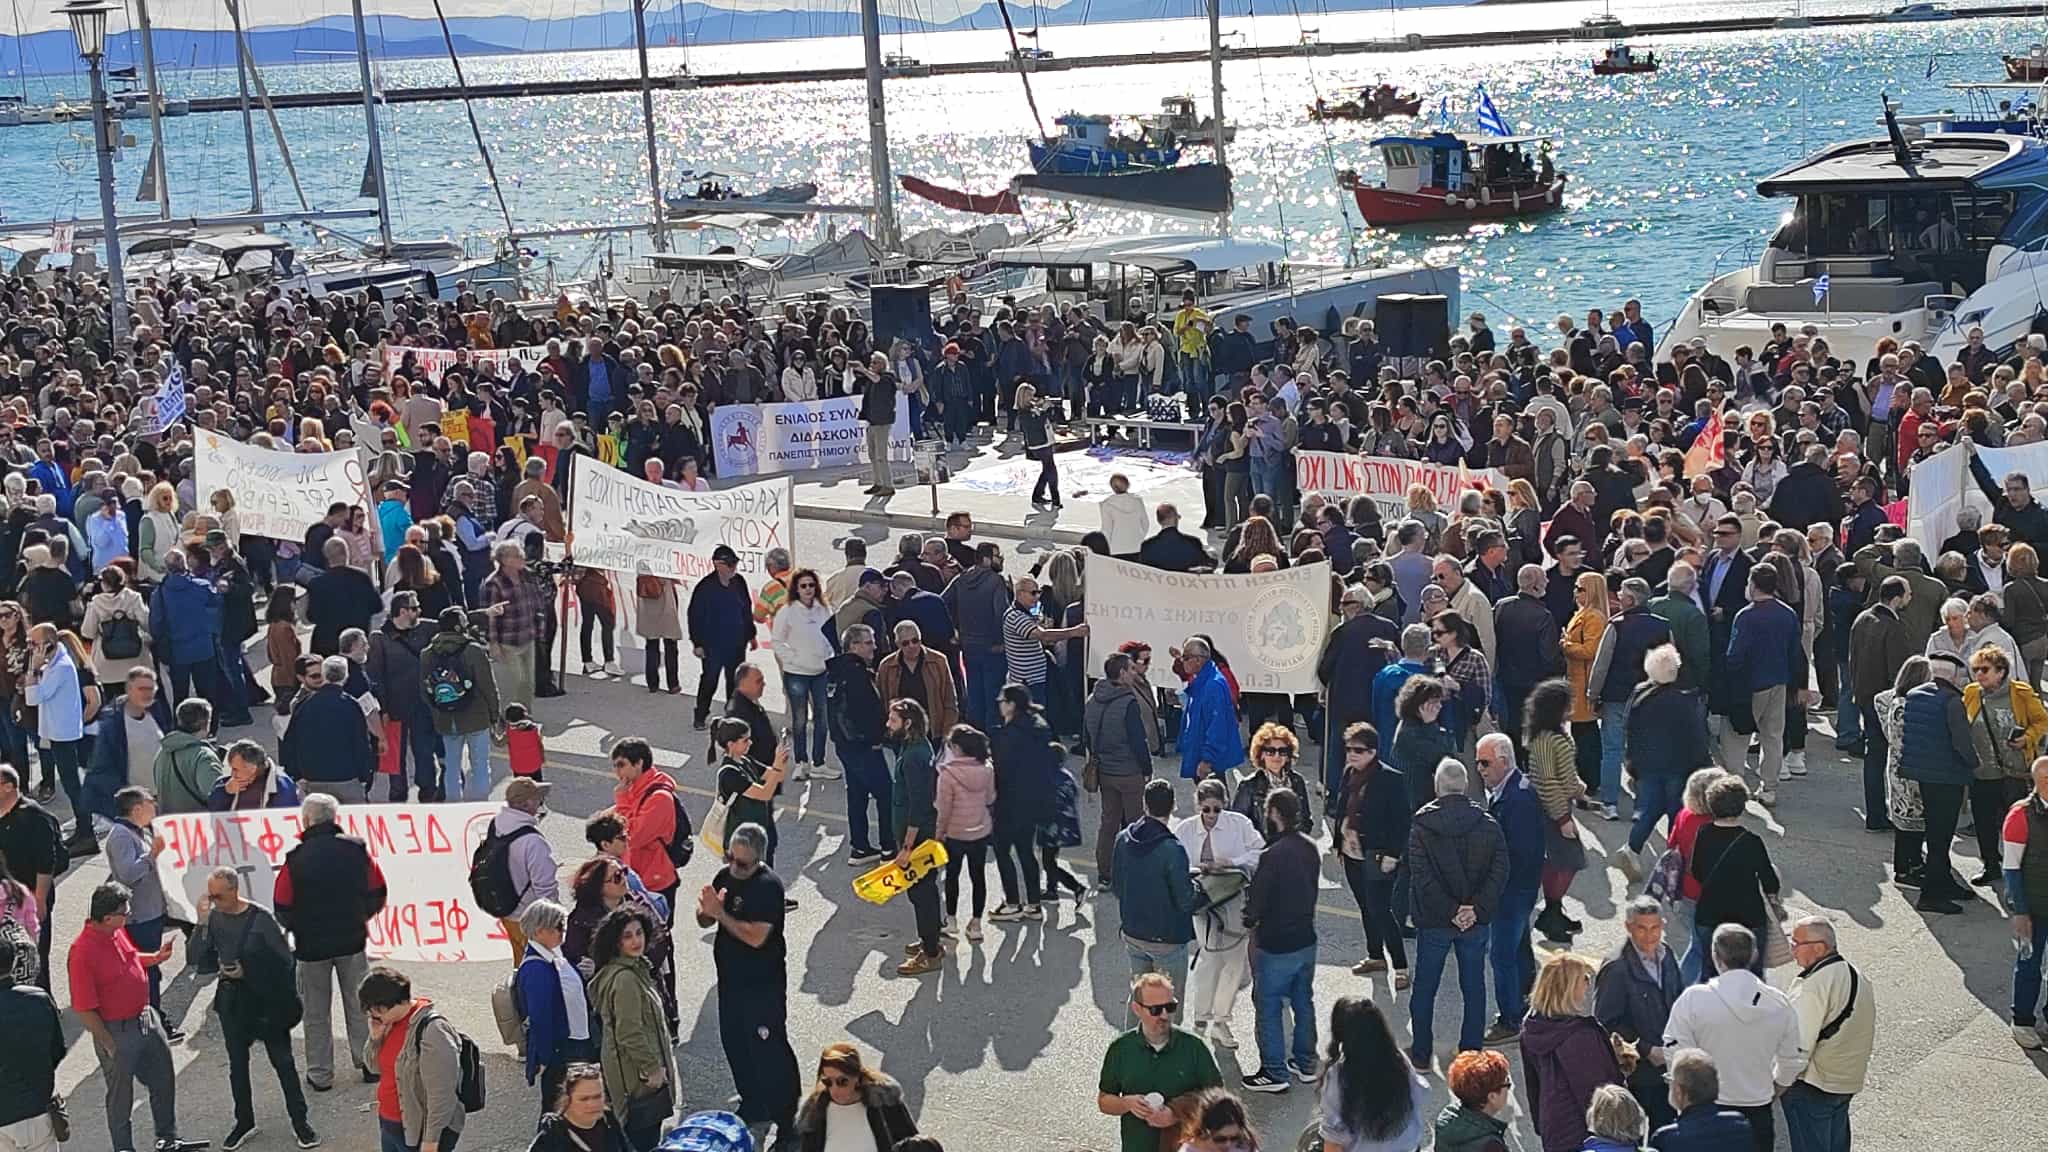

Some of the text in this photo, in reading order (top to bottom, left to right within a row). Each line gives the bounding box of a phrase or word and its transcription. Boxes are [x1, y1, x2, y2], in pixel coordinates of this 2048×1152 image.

[775, 410, 827, 425] ΕΝΙΑΙΟΣ
[790, 427, 865, 443] ΔΙΔΑΣΚΟΝΤ
[768, 445, 850, 461] ΠΑΝΕΠΙΣΤΗΜΙΟΥ
[1298, 456, 1327, 489] ΟΧΙ
[1365, 462, 1401, 495] ΣΤΟΝ
